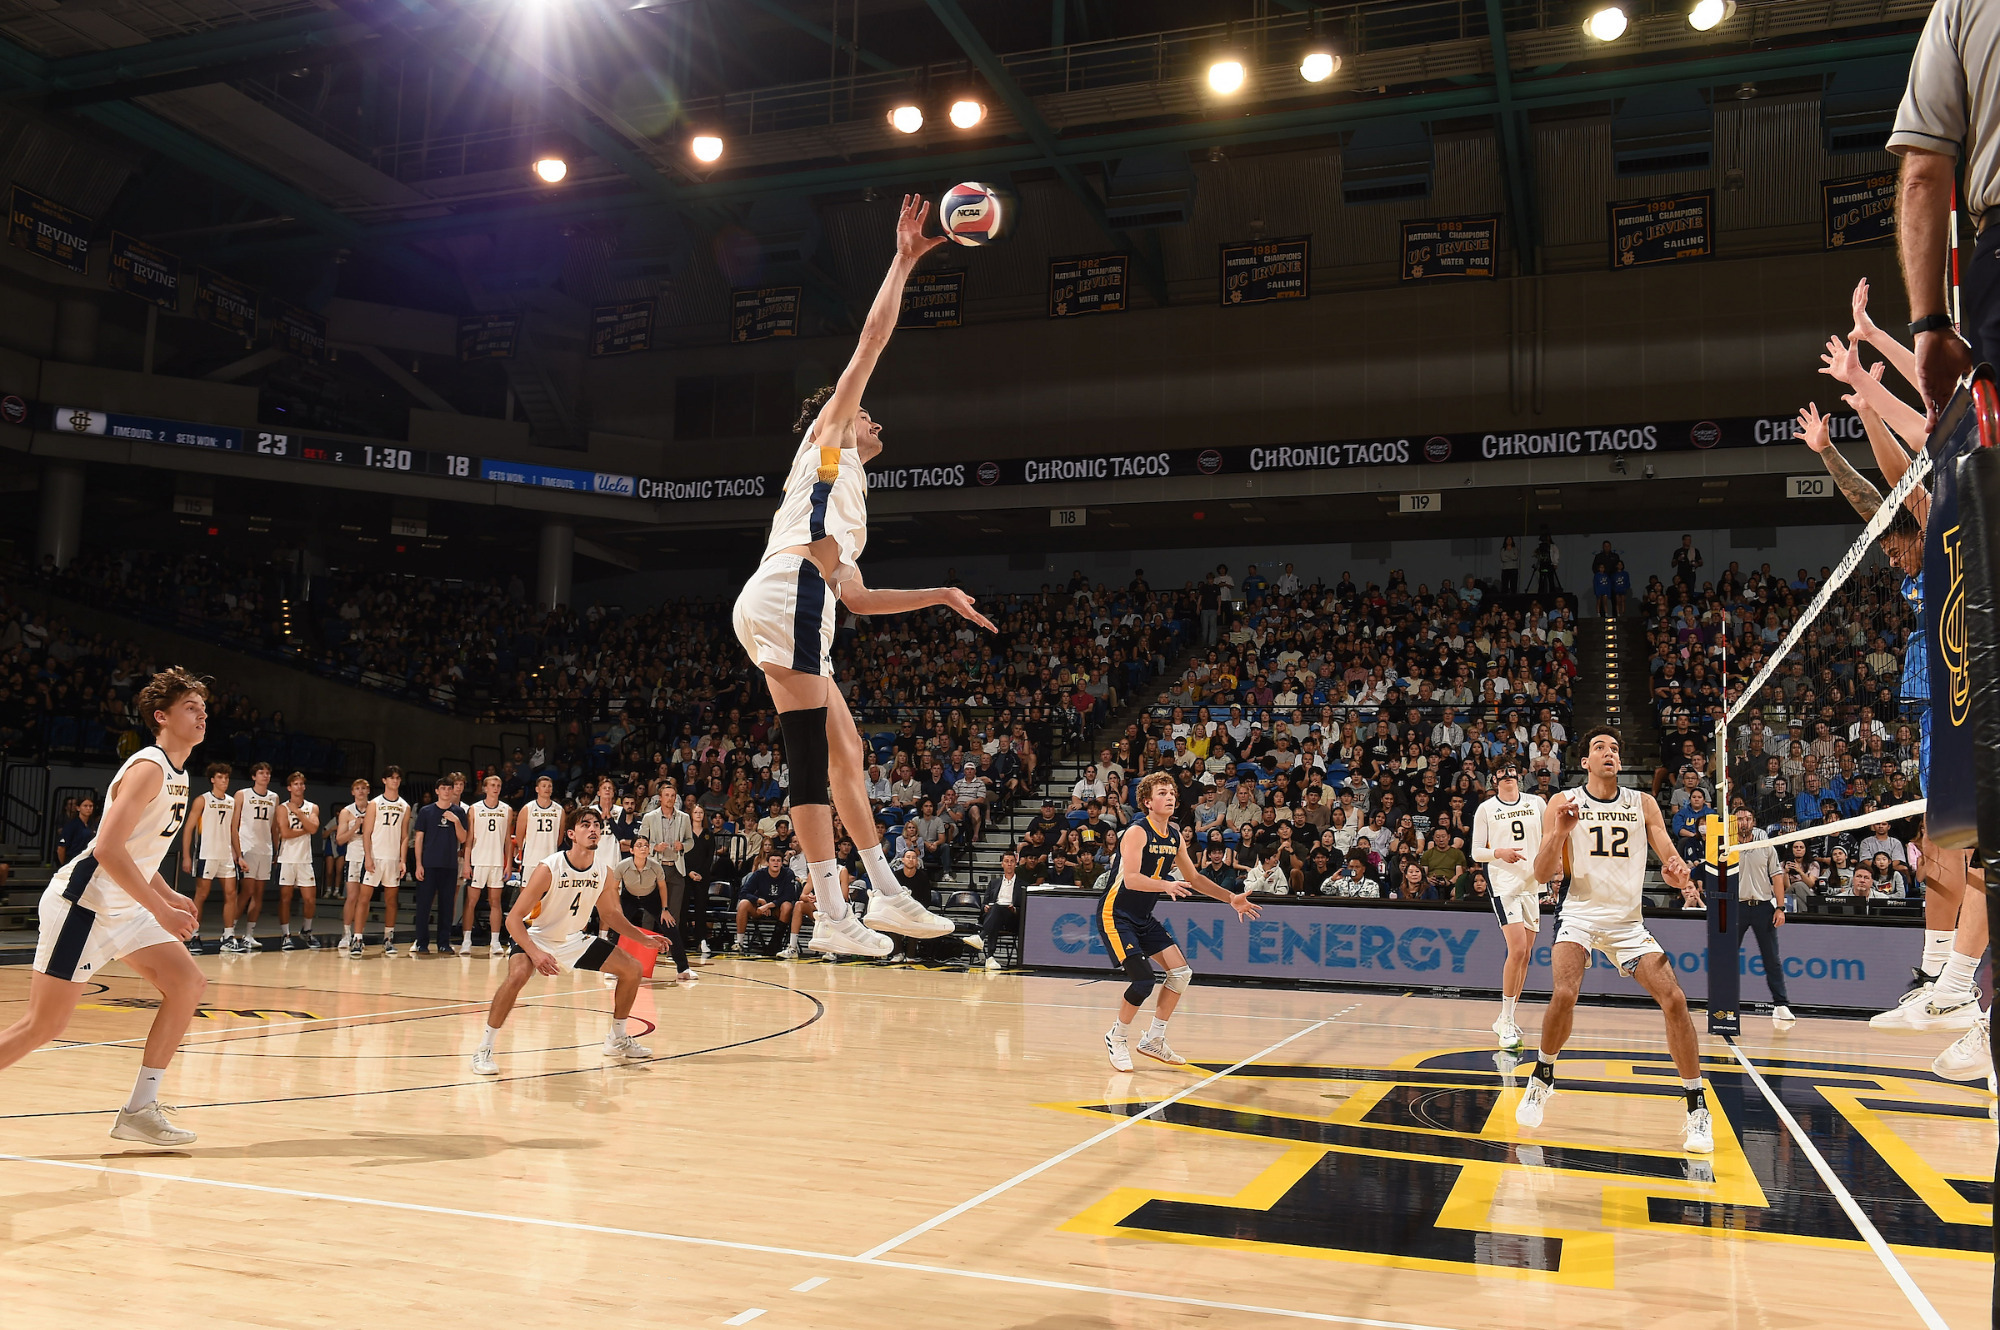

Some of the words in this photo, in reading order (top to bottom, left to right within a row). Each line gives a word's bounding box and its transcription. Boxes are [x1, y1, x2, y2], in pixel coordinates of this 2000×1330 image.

[1866, 175, 1893, 189] 1992
[1833, 191, 1874, 204] NATIONAL
[957, 209, 981, 217] NCAA
[1647, 200, 1676, 213] 1990
[1619, 214, 1654, 226] NATIONAL
[1659, 207, 1703, 220] CHAMPIONS
[1834, 208, 1860, 231] UC
[14, 211, 34, 229] UC
[37, 222, 88, 252] IRVINE
[1437, 222, 1463, 231] 1989
[1408, 232, 1441, 242] NATIONAL
[1449, 230, 1490, 239] CHAMPIONS
[1619, 230, 1644, 252] UC
[1646, 216, 1704, 241] IRVINE
[1664, 235, 1704, 249] SAILING
[1252, 244, 1278, 256] 1988
[1407, 246, 1432, 265] UC
[1436, 239, 1489, 257] IRVINE
[1078, 259, 1100, 269] 1982
[1227, 257, 1258, 266] NATIONAL
[1264, 252, 1302, 263] CHAMPIONS
[1440, 257, 1464, 266] WATER
[1469, 257, 1490, 265] POLO
[113, 254, 131, 271] UC
[133, 262, 177, 288] IRVINE
[1055, 270, 1082, 280] NATIONAL
[1087, 266, 1122, 276] CHAMPIONS
[1227, 272, 1248, 290] UC
[1252, 261, 1302, 282] IRVINE
[917, 274, 936, 284] 1979
[1267, 280, 1301, 289] SAILING
[924, 283, 958, 292] CHAMPIONS
[1054, 285, 1074, 302] UC
[1077, 274, 1121, 293] IRVINE
[912, 293, 957, 309] IRVINE
[1079, 295, 1099, 303] WATER
[1104, 293, 1120, 301] POLO
[217, 295, 256, 320] IRVINE
[924, 310, 956, 318] SAILING
[112, 425, 154, 440] TIMEOUTS:
[158, 431, 166, 442] 2
[176, 433, 195, 445] SETS
[196, 435, 219, 448] WON:
[225, 438, 233, 449] 0
[257, 432, 287, 456] 23
[1482, 431, 1582, 459] CHRONIC
[1583, 425, 1658, 452] TACOS
[303, 447, 329, 461] SET:
[335, 451, 343, 462] 2
[364, 446, 412, 471] 1:30
[1250, 445, 1341, 471] CHRONIC
[1342, 439, 1410, 465] TACOS
[446, 455, 470, 477] 18
[1024, 458, 1108, 483] CHRONIC
[1109, 453, 1171, 478] TACOS
[532, 475, 537, 485] 1
[909, 464, 966, 488] TACOS
[638, 478, 713, 500] CHRONIC
[714, 476, 766, 497] TACOS
[1796, 480, 1823, 494] 120
[184, 500, 202, 512] 115
[1411, 496, 1430, 509] 119
[1059, 511, 1076, 524] 118
[218, 810, 226, 825] 7
[253, 806, 269, 821] 11
[382, 812, 400, 827] 17
[1494, 813, 1506, 821] UC
[1507, 808, 1535, 819] IRVINE
[1578, 811, 1594, 822] UC
[1597, 811, 1638, 823] IRVINE
[488, 819, 496, 832] 8
[536, 819, 553, 832] 13
[1511, 820, 1526, 842] 9
[1589, 825, 1630, 858] 12
[1149, 844, 1159, 854] UC
[1151, 856, 1166, 880] 1
[558, 880, 570, 889] UC
[572, 879, 599, 889] IRVINE
[569, 892, 582, 917] 4
[1247, 919, 1481, 973] ENERGY
